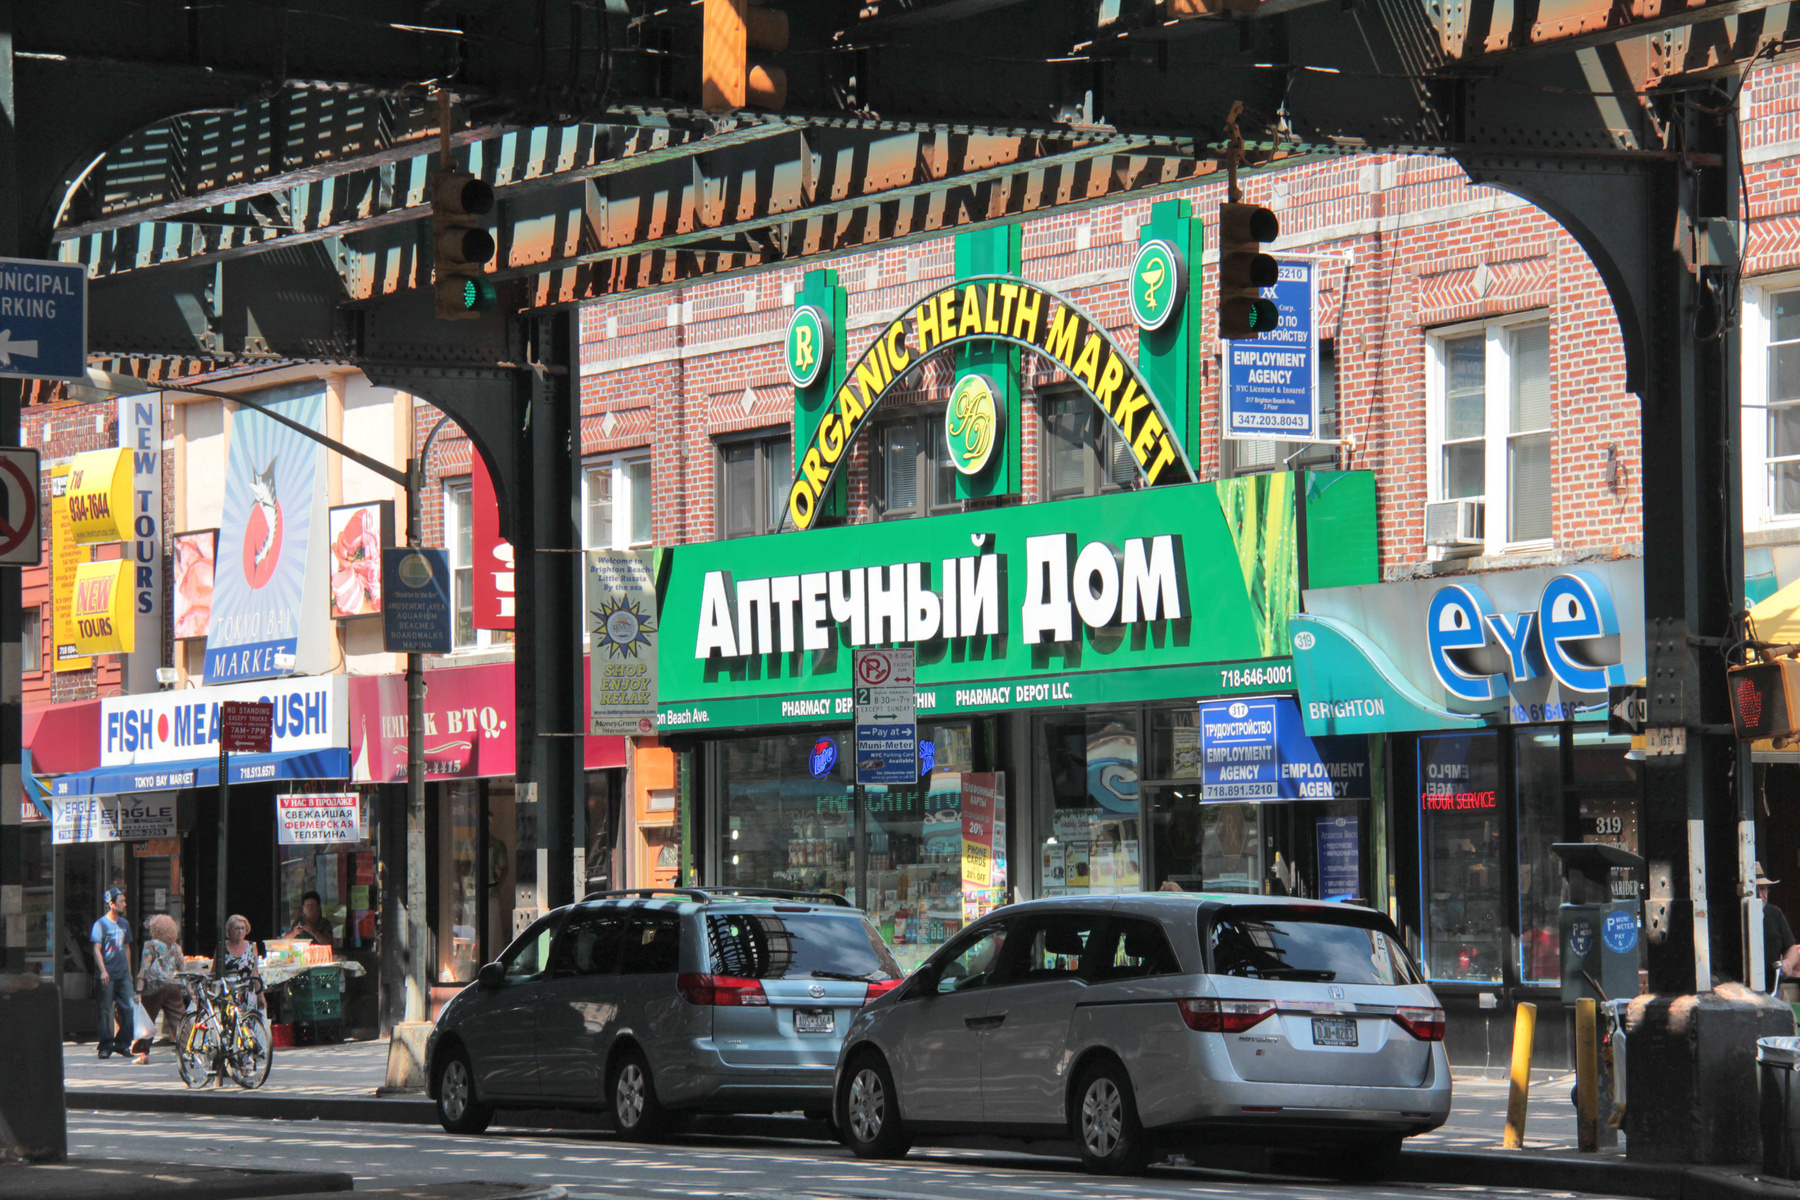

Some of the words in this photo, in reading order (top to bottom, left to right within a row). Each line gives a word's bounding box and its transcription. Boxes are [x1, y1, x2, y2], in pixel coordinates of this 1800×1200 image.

[1279, 268, 1303, 279] 5210
[0, 271, 75, 296] NICIPAL
[1279, 304, 1296, 312] Corp.
[1286, 316, 1298, 327] ПО
[1234, 351, 1306, 367] EMPLOYMENT
[1248, 369, 1292, 384] AGENCY
[1236, 384, 1248, 392] NYC
[1250, 385, 1275, 394] Licensed
[1283, 386, 1305, 394] Insured
[790, 321, 910, 529] ORGANIC
[916, 282, 1042, 350] HEALTH
[1045, 305, 1176, 485] MARKET
[1238, 414, 1304, 426] 347.203.8043
[133, 402, 157, 475] NEW
[70, 469, 84, 490] 718
[69, 492, 110, 522] 934-7644
[134, 490, 155, 614] TOURS
[590, 566, 625, 574] Brighton
[76, 574, 116, 616] NEW
[603, 584, 613, 592] By
[695, 533, 999, 659] АПТЕЧНЫЙ
[1022, 532, 1182, 645] ДОМ
[428, 603, 446, 611] AREA
[77, 617, 113, 639] TOURS
[216, 612, 260, 642] TOKYO
[267, 607, 295, 636] BAY
[1297, 633, 1312, 649] 319
[603, 664, 647, 677] SHOP
[1221, 665, 1292, 688] 718-646-0001
[600, 678, 651, 691] ENJOY
[600, 692, 651, 706] RELAX
[859, 688, 868, 704] 2
[956, 686, 1010, 707] PHARMACY
[1016, 684, 1050, 703] DEPOT
[1052, 681, 1073, 700] LLC.
[239, 707, 270, 715] STANDING
[782, 699, 830, 717] PHARMACY
[835, 697, 854, 714] DEP
[913, 692, 936, 709] HIN
[1231, 705, 1246, 715] 317
[1309, 698, 1385, 720] BRIGHTON
[1627, 701, 1645, 719] ON
[108, 708, 153, 753] FISH
[174, 702, 221, 747] MEA
[258, 690, 327, 739] USHI
[657, 714, 666, 726] on
[667, 709, 692, 726] Beach
[693, 708, 710, 723] Ave.
[1503, 705, 1526, 723] 718
[446, 706, 507, 739] BTQ.
[595, 720, 637, 729] MoneyGram
[1205, 718, 1272, 739] ТРУДОУСТРОЙСТВО
[872, 728, 888, 738] Pay
[890, 728, 900, 736] at
[860, 741, 913, 750] Muni-Meter
[1207, 745, 1272, 763] EMPLOYMENT
[240, 765, 276, 779] 718.513.6570
[1219, 764, 1260, 781] AGENCY
[1281, 763, 1364, 779] EMPLOYMENT
[135, 774, 154, 788] TOKYO
[156, 774, 167, 787] BAY
[169, 772, 194, 785] MARKET
[58, 783, 68, 794] 309
[1207, 784, 1273, 797] 718.891.5210
[1299, 781, 1348, 797] AGENCY
[65, 800, 97, 815] EAGLE
[283, 799, 289, 807] У
[291, 798, 306, 807] НАС
[308, 798, 314, 806] В
[316, 797, 353, 806] ПРОДАЖЕ
[1428, 793, 1454, 809] HOUR
[1456, 791, 1496, 809] SERVICE
[102, 806, 172, 819] EAGLE
[285, 808, 352, 819] СВЕЖАЙШАЯ
[284, 820, 353, 829] ФЕРМЕРСКАЯ
[969, 822, 983, 836] 20%
[1596, 816, 1622, 834] 319
[294, 830, 346, 839] ТЕЛЯТИНА
[967, 844, 987, 857] PHONE
[966, 854, 986, 867] CARDS
[976, 872, 986, 882] OFF
[1616, 922, 1635, 930] METER
